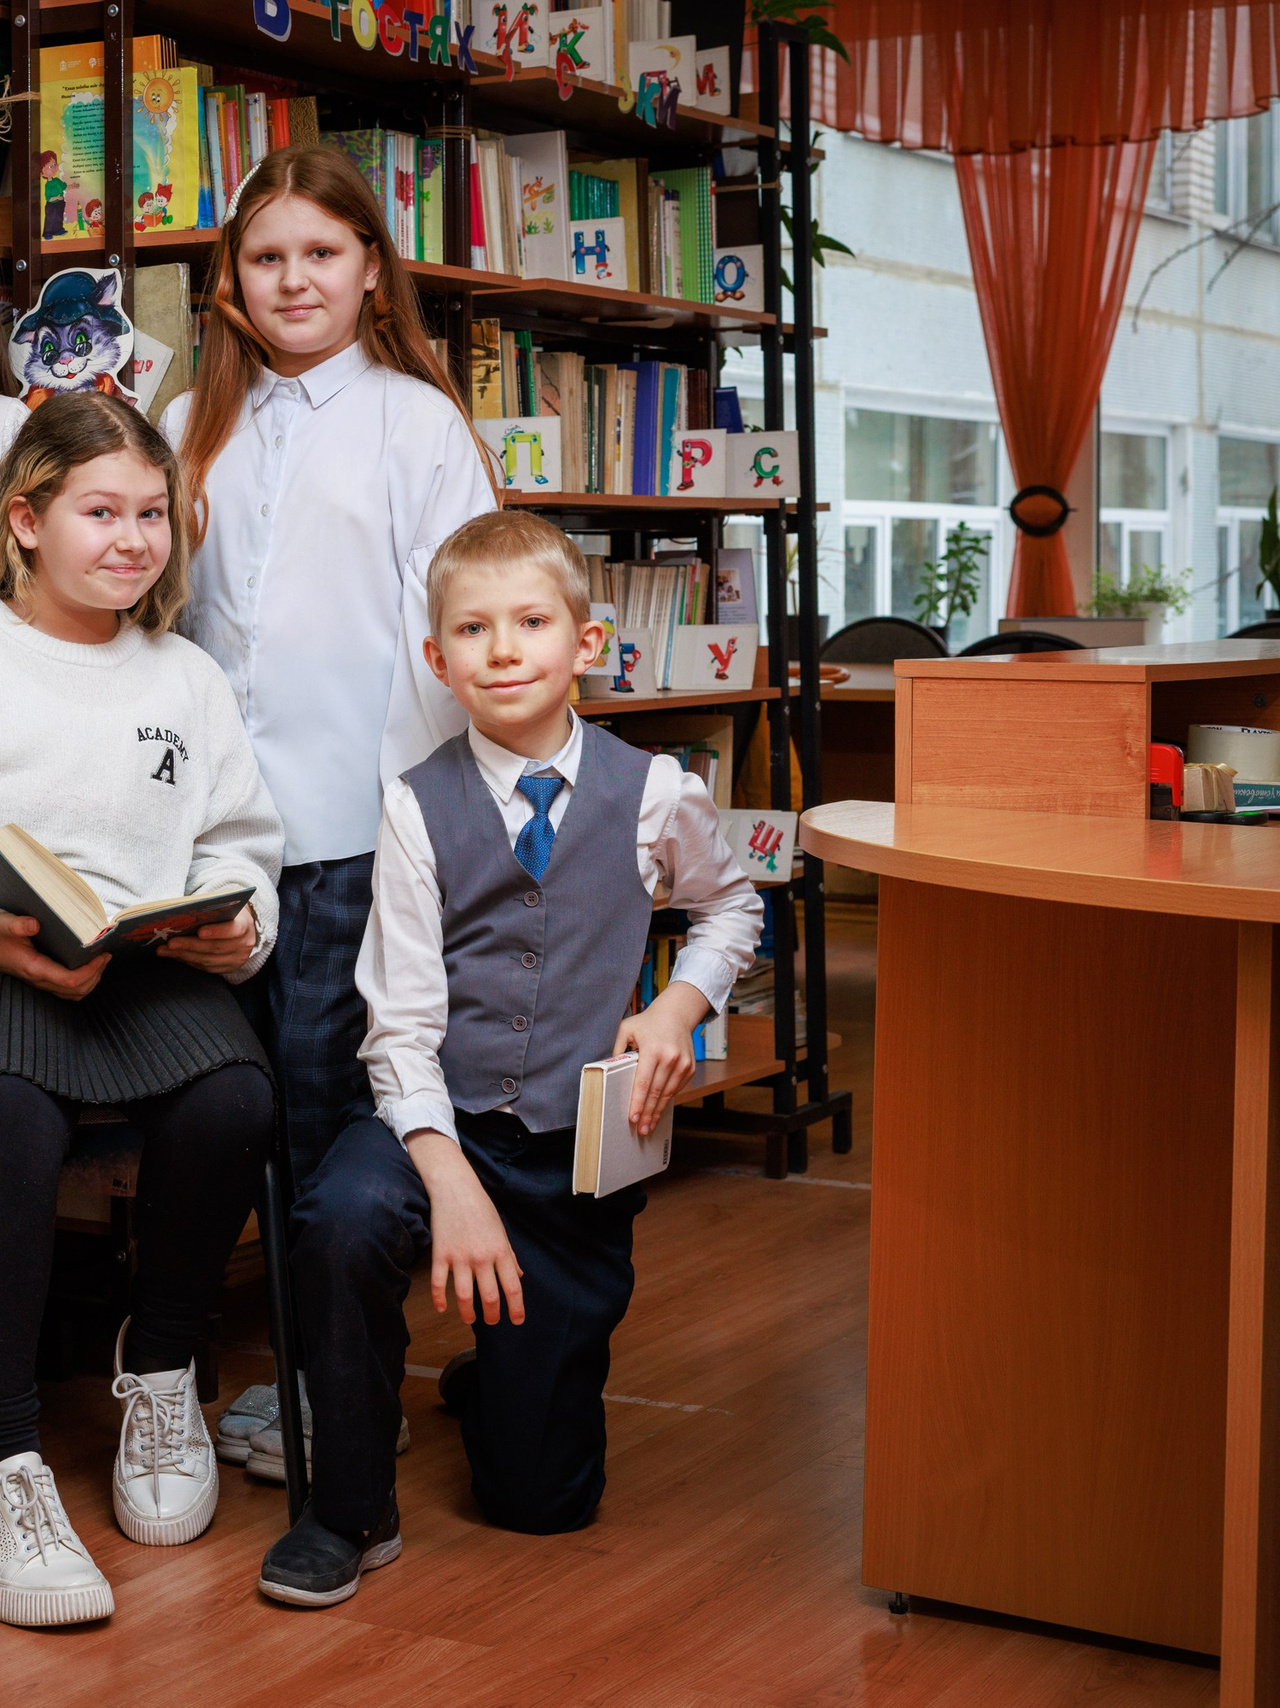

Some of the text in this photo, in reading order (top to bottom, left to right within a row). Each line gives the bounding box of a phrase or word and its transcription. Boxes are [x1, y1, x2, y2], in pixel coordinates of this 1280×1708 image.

[574, 229, 608, 276] Н
[715, 255, 748, 295] О
[504, 431, 543, 486] П
[679, 438, 712, 491] Р
[753, 446, 782, 482] С
[708, 636, 738, 681] У
[136, 726, 190, 764] ACADEMY
[150, 748, 176, 788] A
